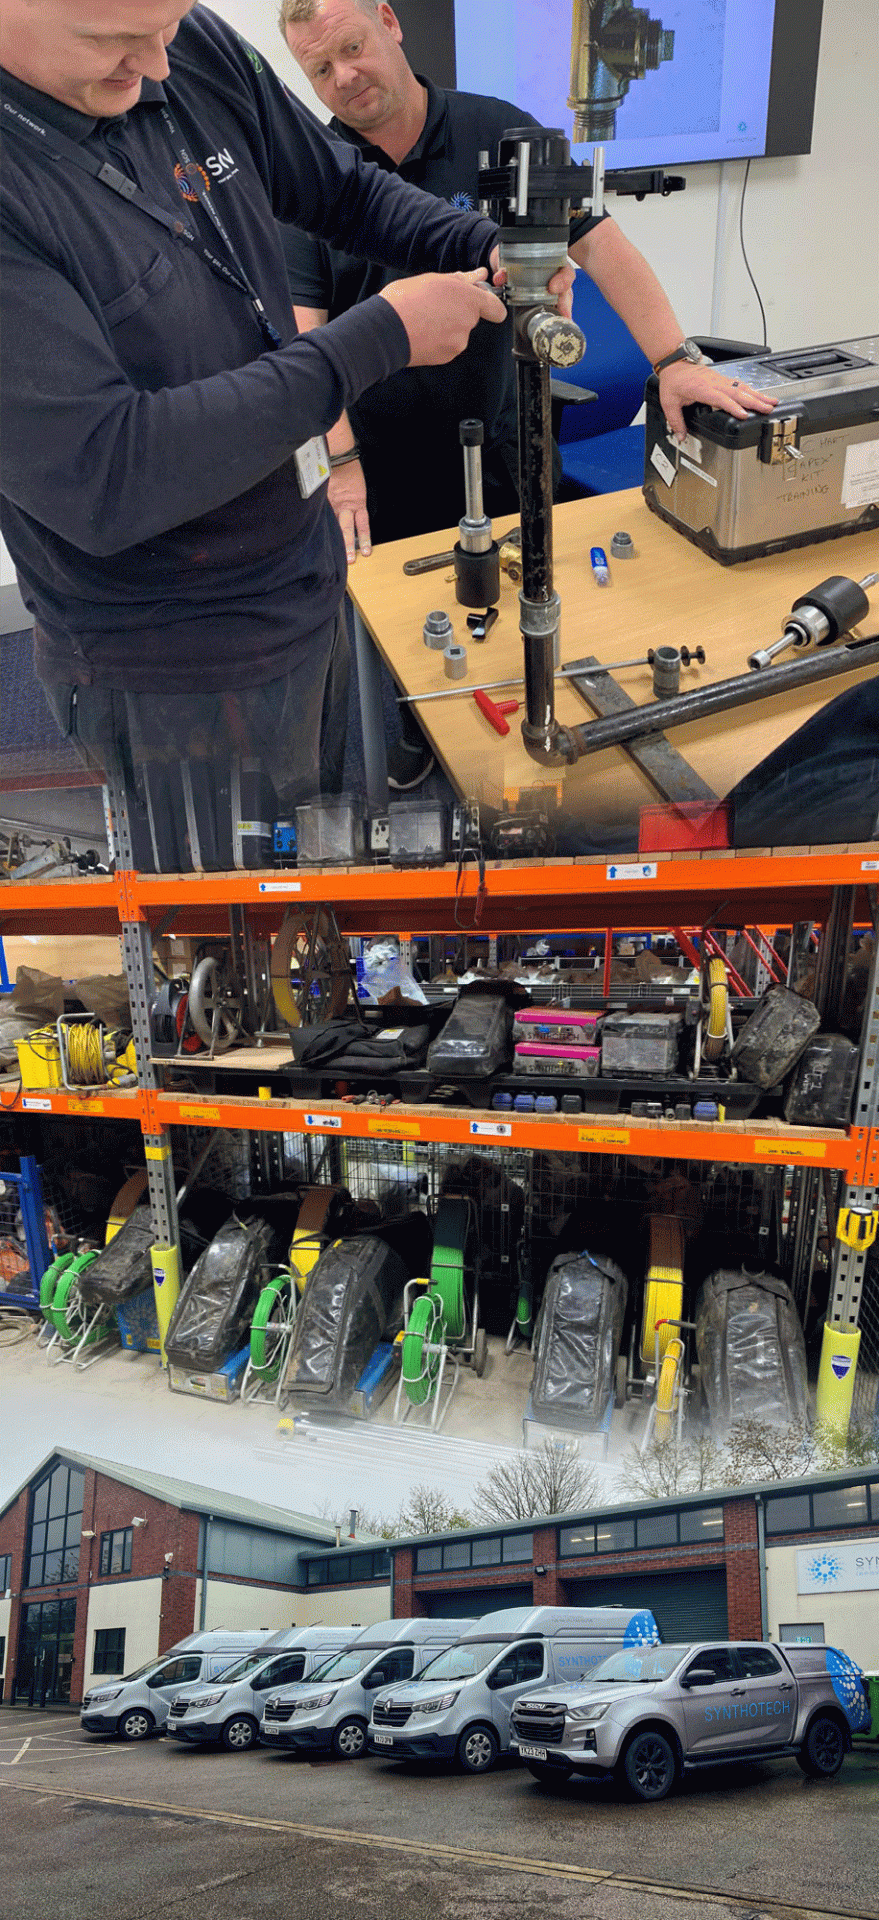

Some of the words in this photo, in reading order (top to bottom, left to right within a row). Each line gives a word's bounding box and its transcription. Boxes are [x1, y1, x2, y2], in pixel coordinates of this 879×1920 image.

[3, 103, 18, 115] Our
[776, 484, 829, 503] TRAINING
[704, 1700, 790, 1721] SYNTHOTECH
